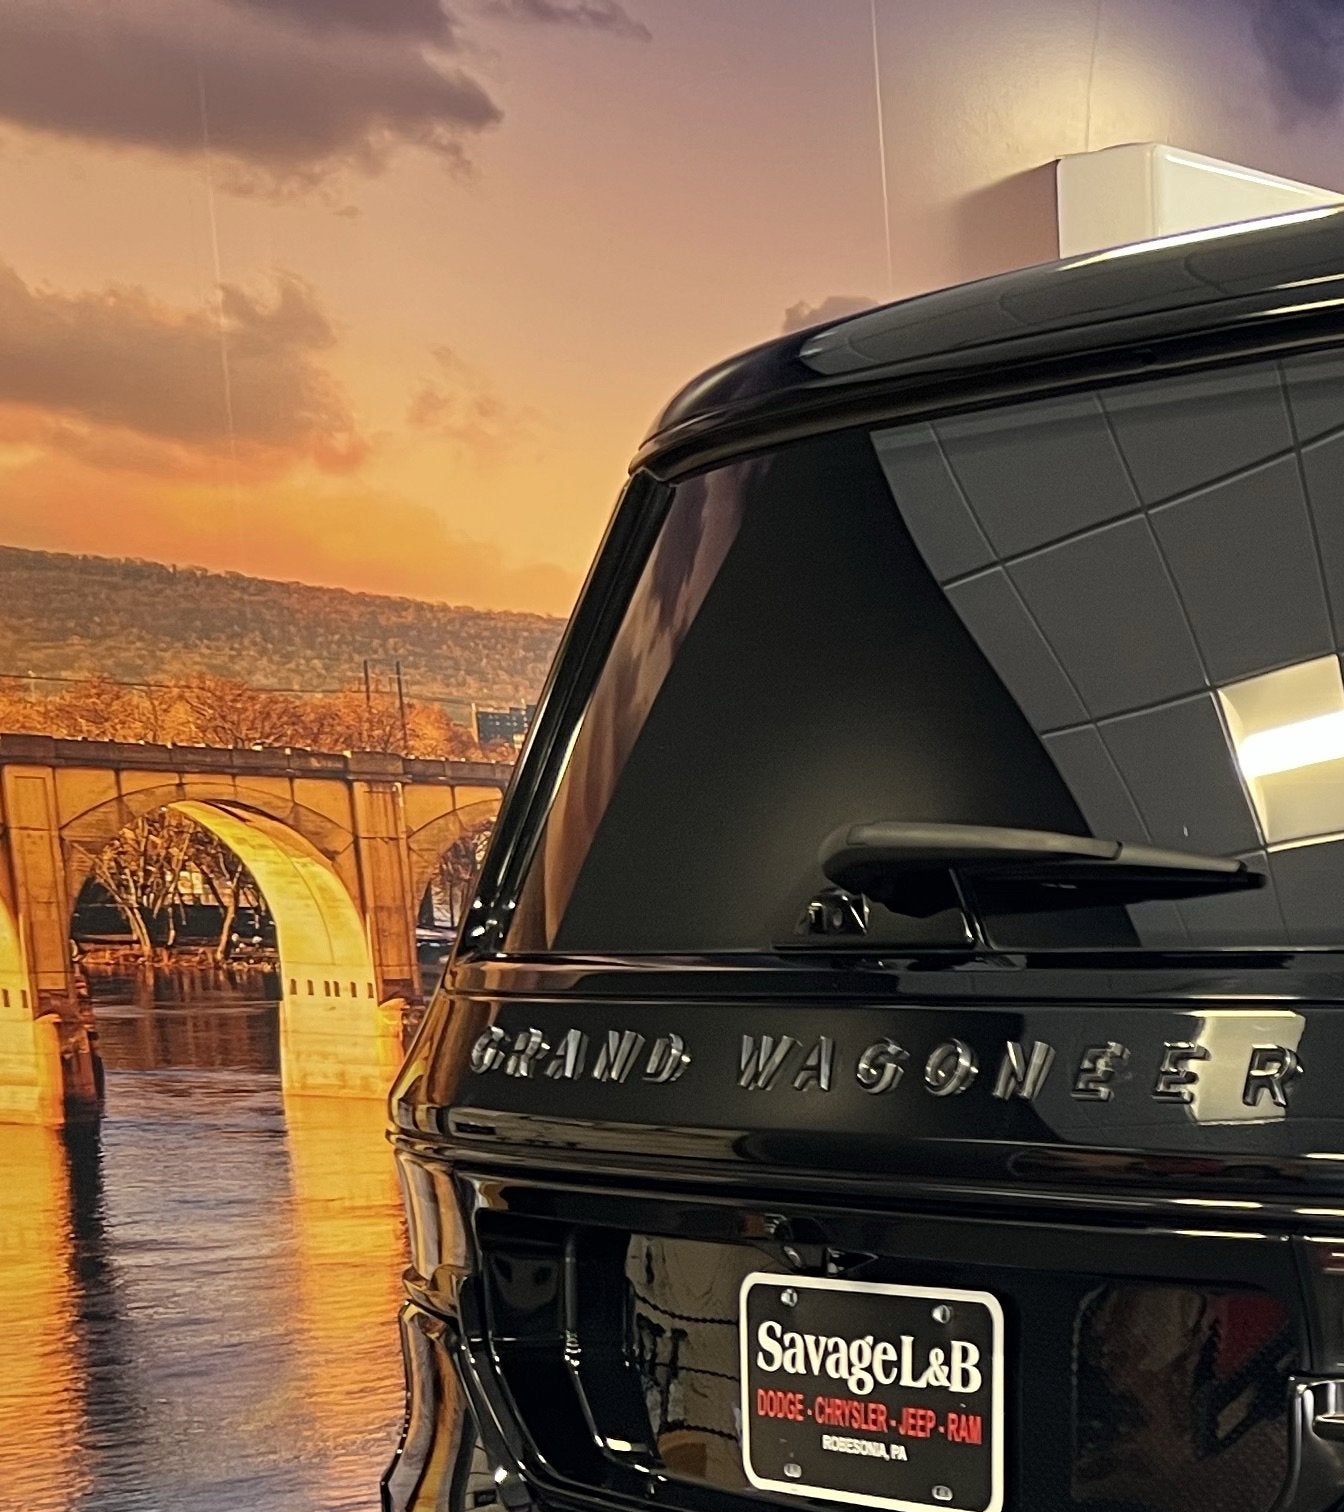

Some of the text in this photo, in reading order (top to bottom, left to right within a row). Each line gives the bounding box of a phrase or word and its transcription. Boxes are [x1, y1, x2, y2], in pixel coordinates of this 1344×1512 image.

[470, 1025, 1304, 1108] GRAND WAGONEER
[757, 1389, 982, 1445] DODGE CHRYSLER JEEP RAM
[890, 1444, 908, 1462] PA
